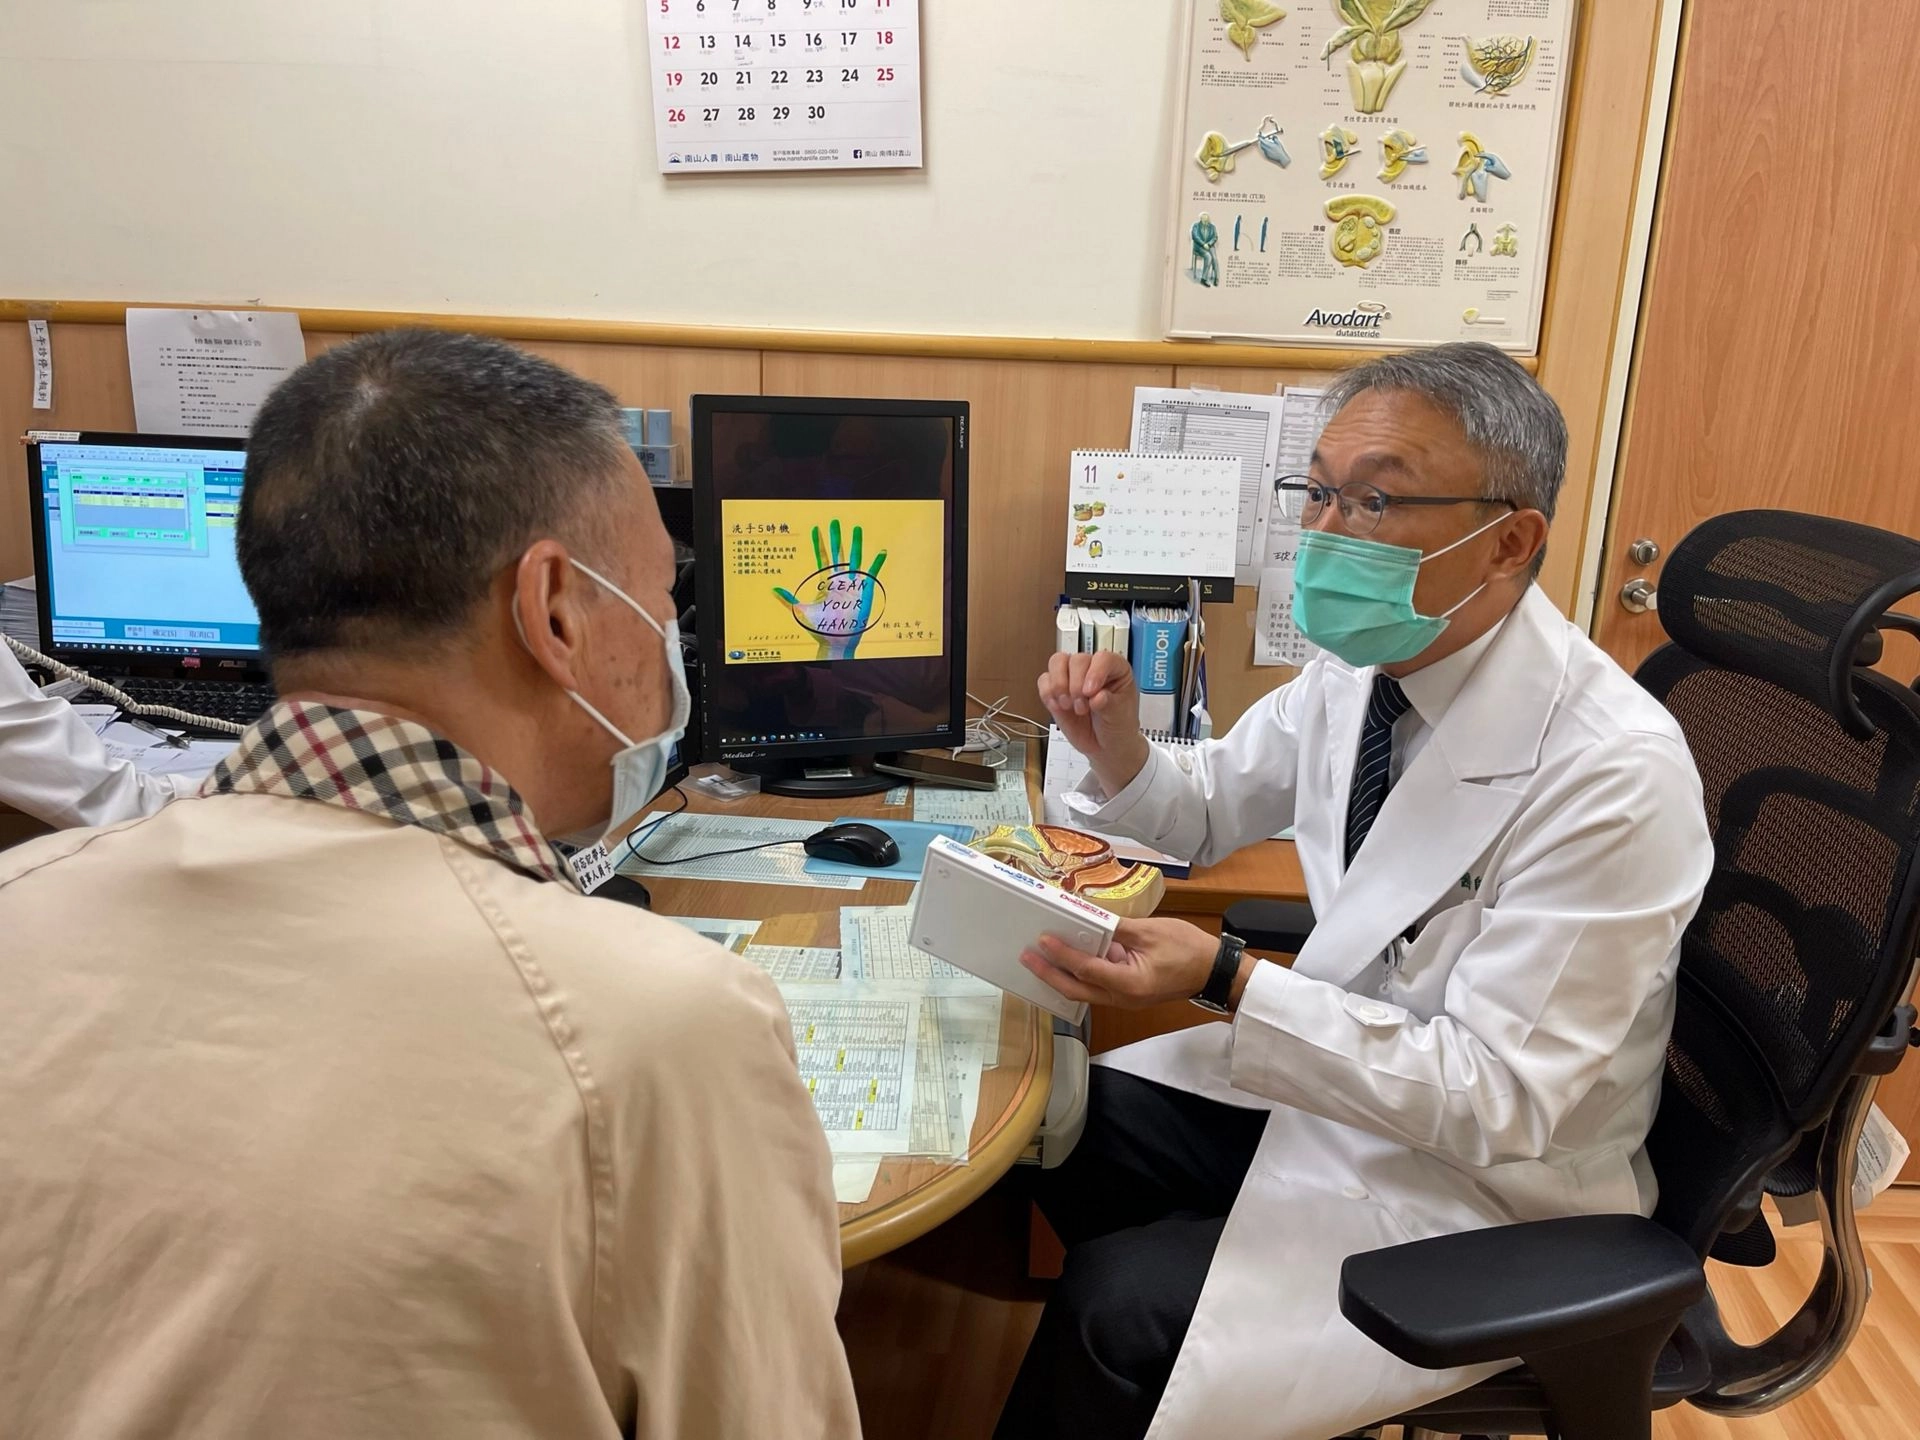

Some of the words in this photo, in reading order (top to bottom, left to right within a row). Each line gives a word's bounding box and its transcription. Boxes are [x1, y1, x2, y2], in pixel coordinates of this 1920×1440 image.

[661, 0, 669, 12] 5
[696, 0, 705, 12] 6
[732, 0, 741, 11] 7
[768, 0, 776, 10] 8
[803, 0, 812, 9] 9
[664, 36, 680, 49] 12
[700, 35, 716, 48] 13
[735, 34, 751, 47] 14
[770, 34, 786, 46] 15
[806, 33, 822, 46] 16
[841, 32, 857, 45] 17
[877, 31, 893, 44] 18
[666, 73, 683, 86] 19
[700, 72, 718, 85] 20
[736, 71, 751, 84] 21
[771, 71, 788, 83] 22
[806, 70, 824, 82] 23
[841, 69, 859, 82] 24
[877, 68, 894, 81] 25
[668, 109, 685, 122] 26
[703, 109, 720, 121] 27
[738, 108, 755, 120] 28
[773, 107, 790, 119] 29
[808, 106, 825, 119] 30
[684, 154, 718, 163] 南山人壽
[1336, 329, 1380, 339] dutasteride
[1084, 465, 1097, 483] 11
[732, 523, 790, 534] 洗手5時機
[817, 579, 868, 591] CLEAN
[821, 600, 863, 611] YOUR
[815, 618, 869, 631] HANDS
[722, 751, 753, 760] Medical
[573, 845, 607, 872] 別忘記帶走
